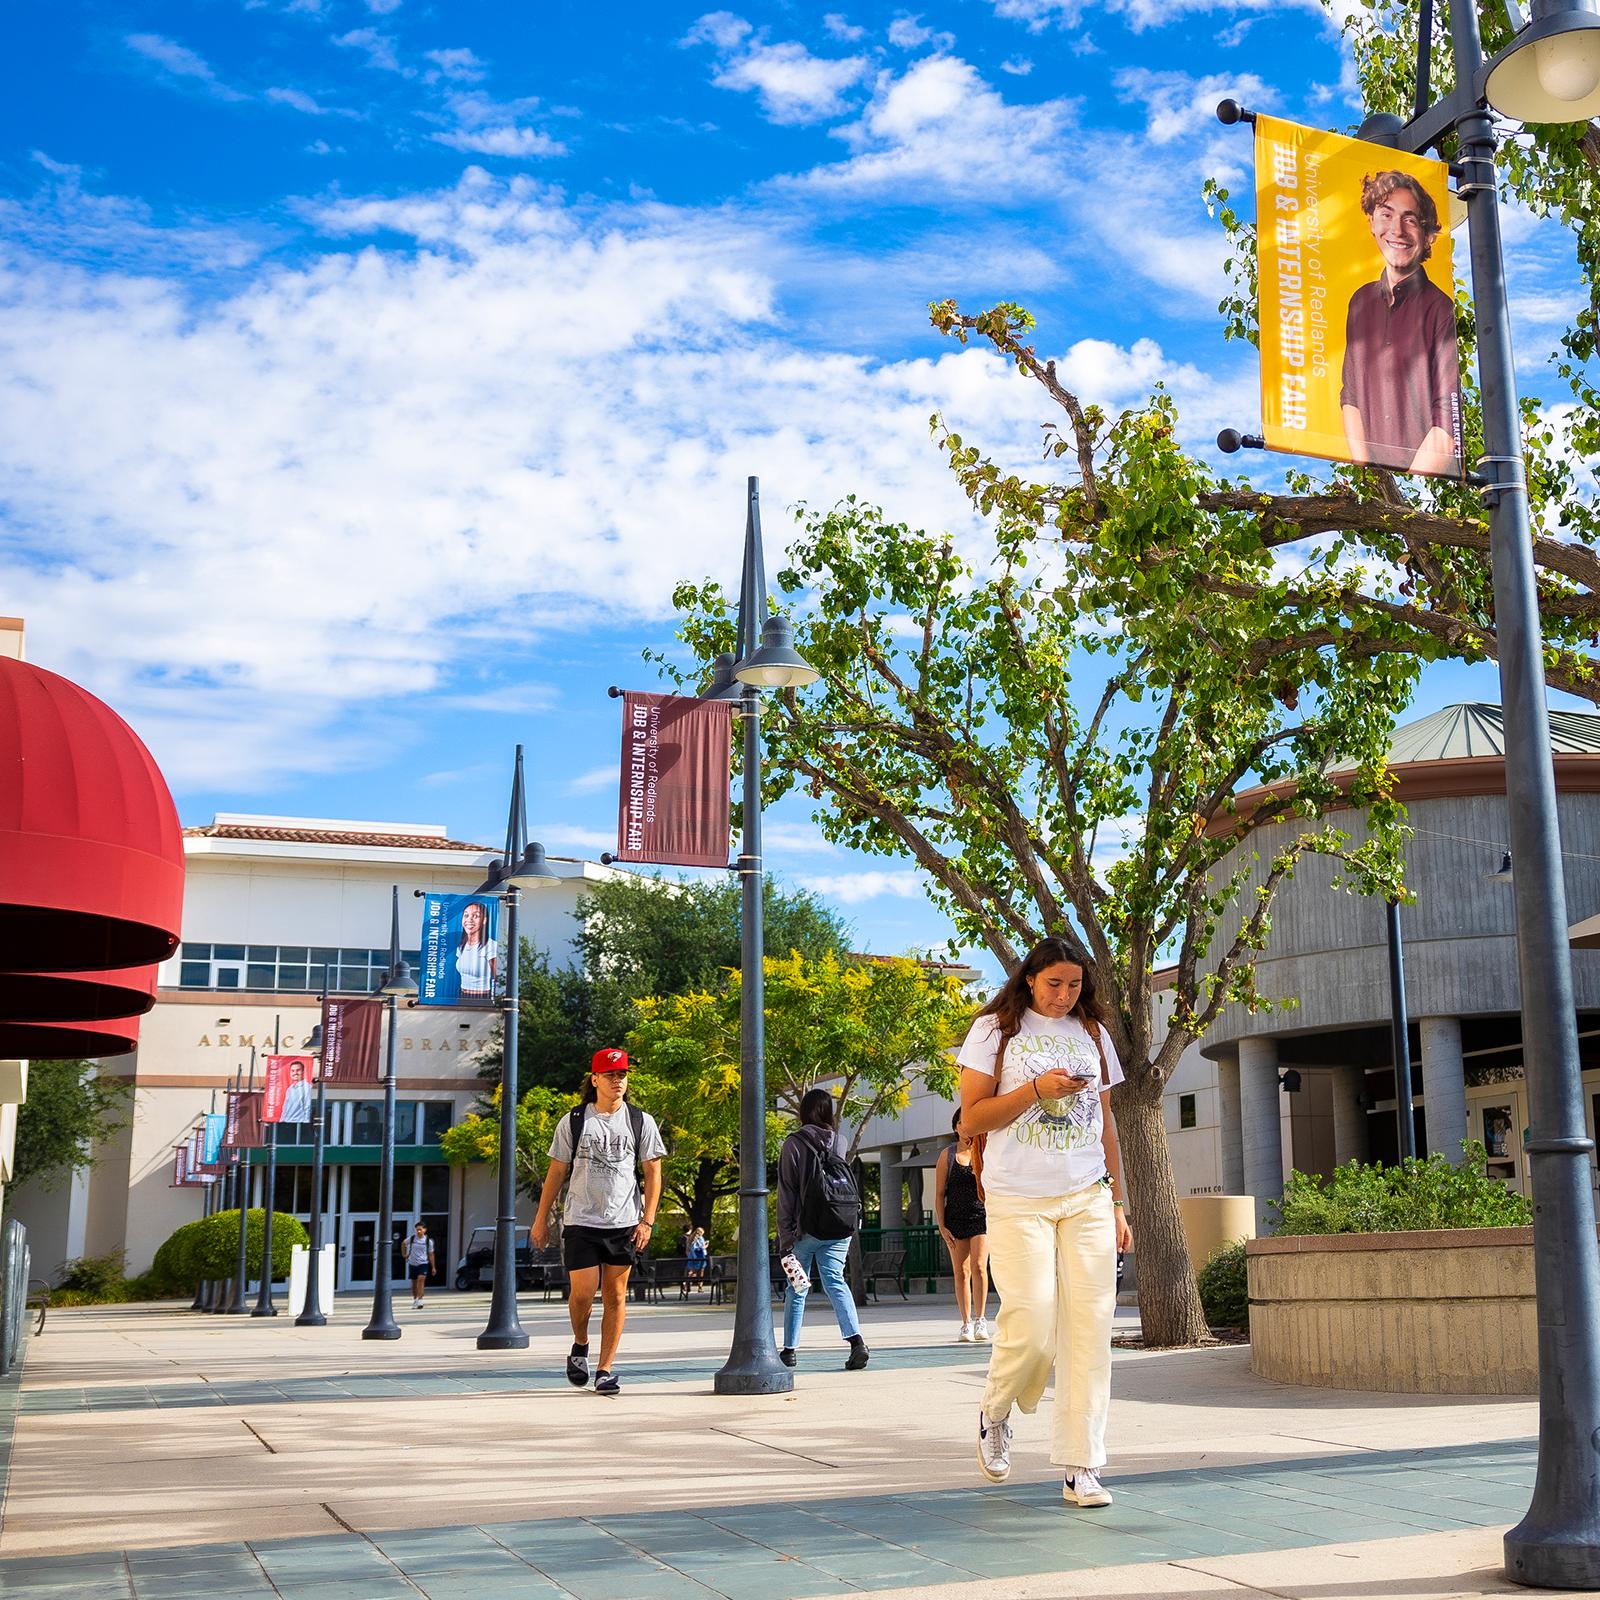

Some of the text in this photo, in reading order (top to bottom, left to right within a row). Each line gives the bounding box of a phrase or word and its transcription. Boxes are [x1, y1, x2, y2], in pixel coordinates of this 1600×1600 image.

[1304, 153, 1329, 378] University of Redlands
[1273, 143, 1307, 430] JOB & INTERNSHIP FAIR
[1450, 392, 1460, 421] GABRIEL
[1452, 422, 1461, 446] BAKER
[627, 704, 647, 851] JOB & INTERNSHIP FAIR
[646, 706, 661, 823] University of Redlands
[430, 901, 441, 916] JOB
[427, 927, 439, 977] INTERNSHIP
[438, 902, 449, 979] University of Redlands
[425, 980, 436, 998] FAIR
[329, 1004, 338, 1016] JOB
[326, 1023, 337, 1061] INTERNSHIP
[325, 1062, 334, 1077] FAIR
